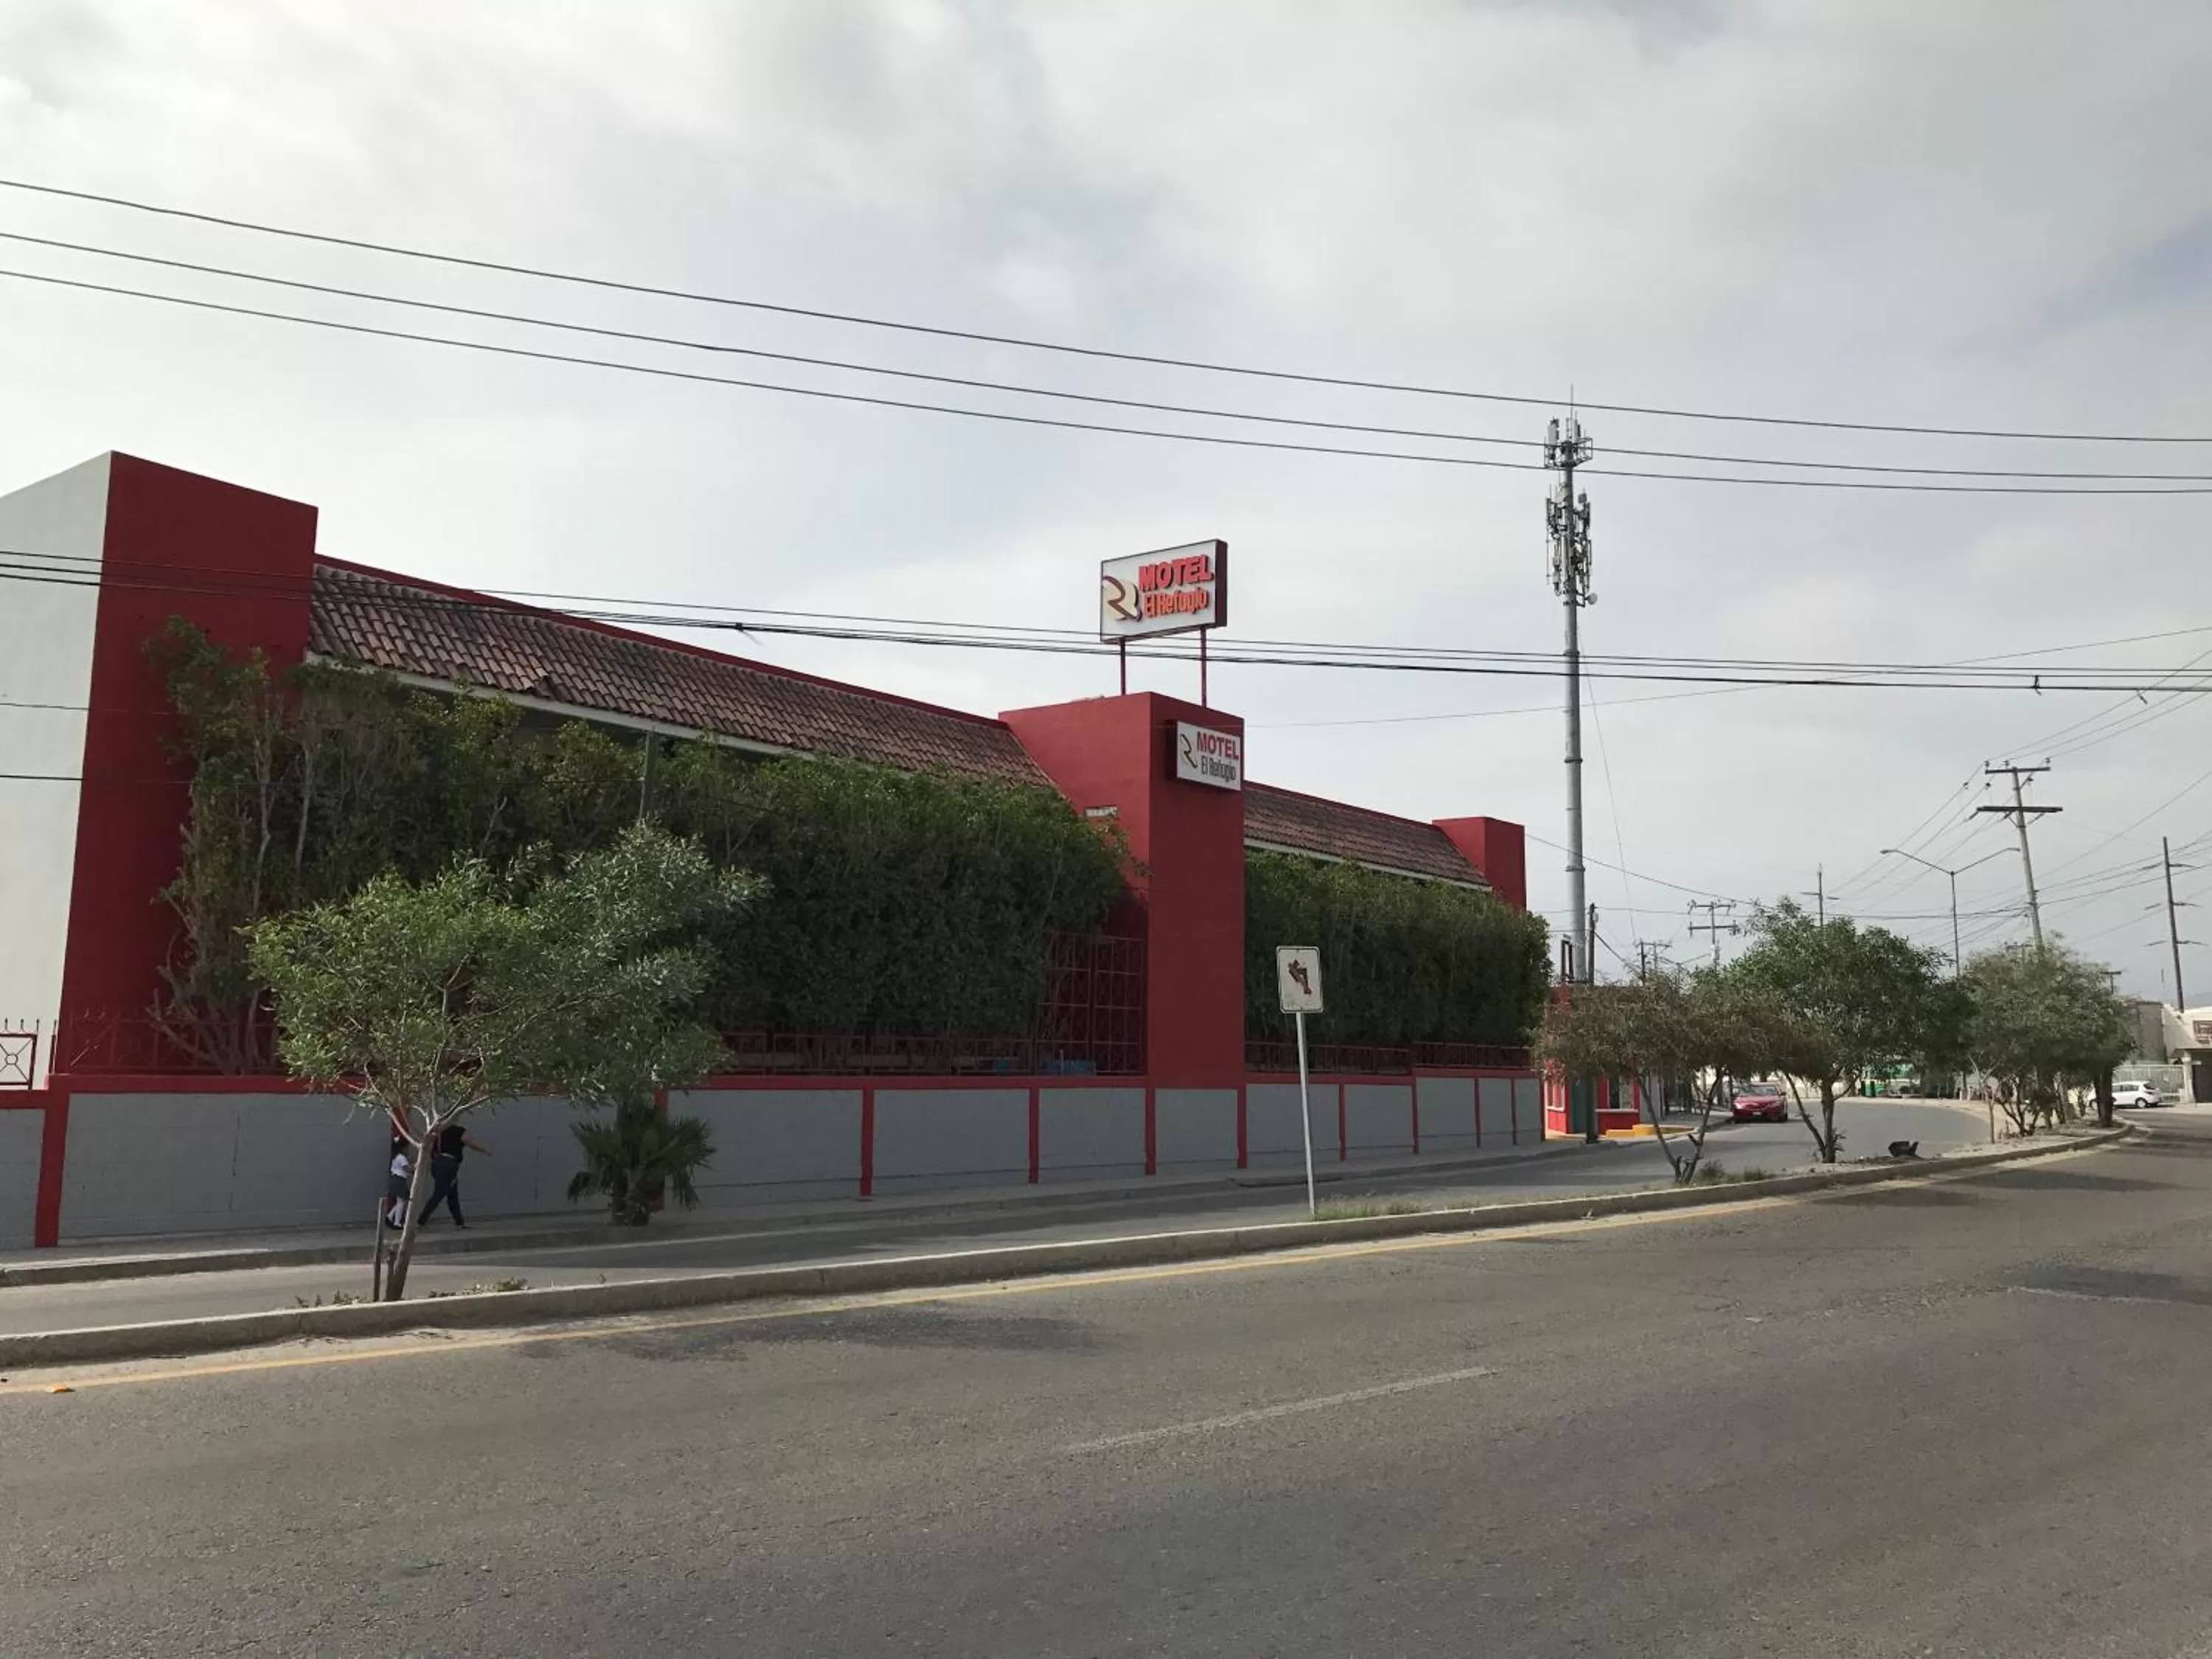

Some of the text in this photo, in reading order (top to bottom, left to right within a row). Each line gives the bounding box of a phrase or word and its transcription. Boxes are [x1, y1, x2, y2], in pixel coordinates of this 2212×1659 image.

[1138, 554, 1214, 592] MOTEL
[1144, 592, 1158, 618] El
[1197, 731, 1239, 761] MOTEL
